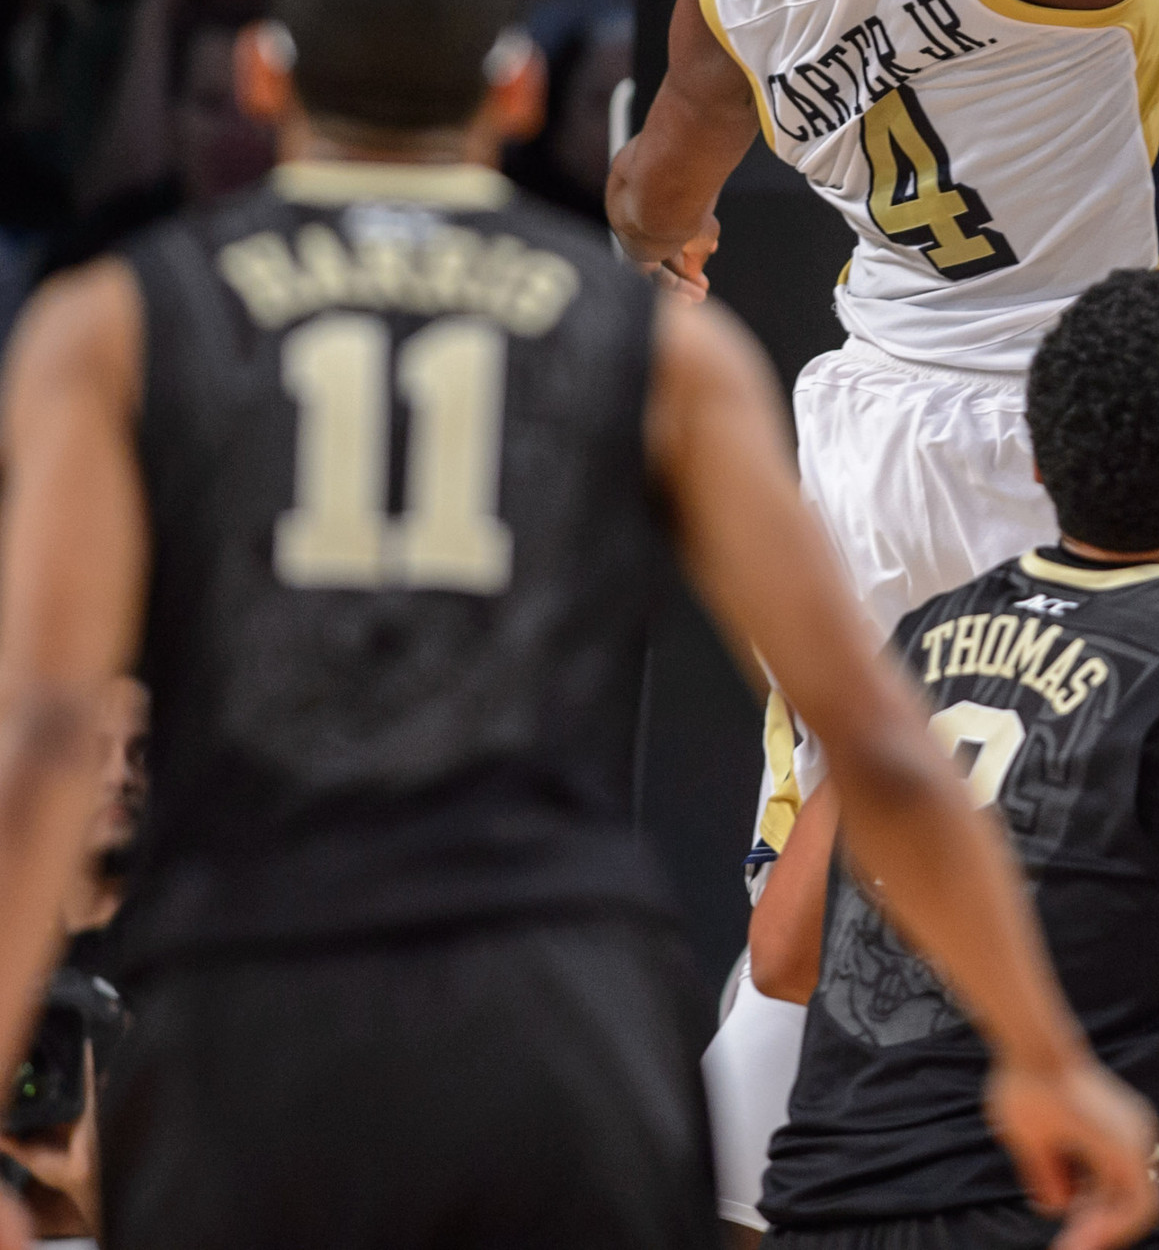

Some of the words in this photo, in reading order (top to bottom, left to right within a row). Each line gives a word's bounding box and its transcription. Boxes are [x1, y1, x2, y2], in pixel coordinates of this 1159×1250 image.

[767, 15, 921, 143] CARTER
[860, 82, 1020, 282] 4
[273, 308, 514, 596] 11
[921, 613, 1109, 716] THOMAS
